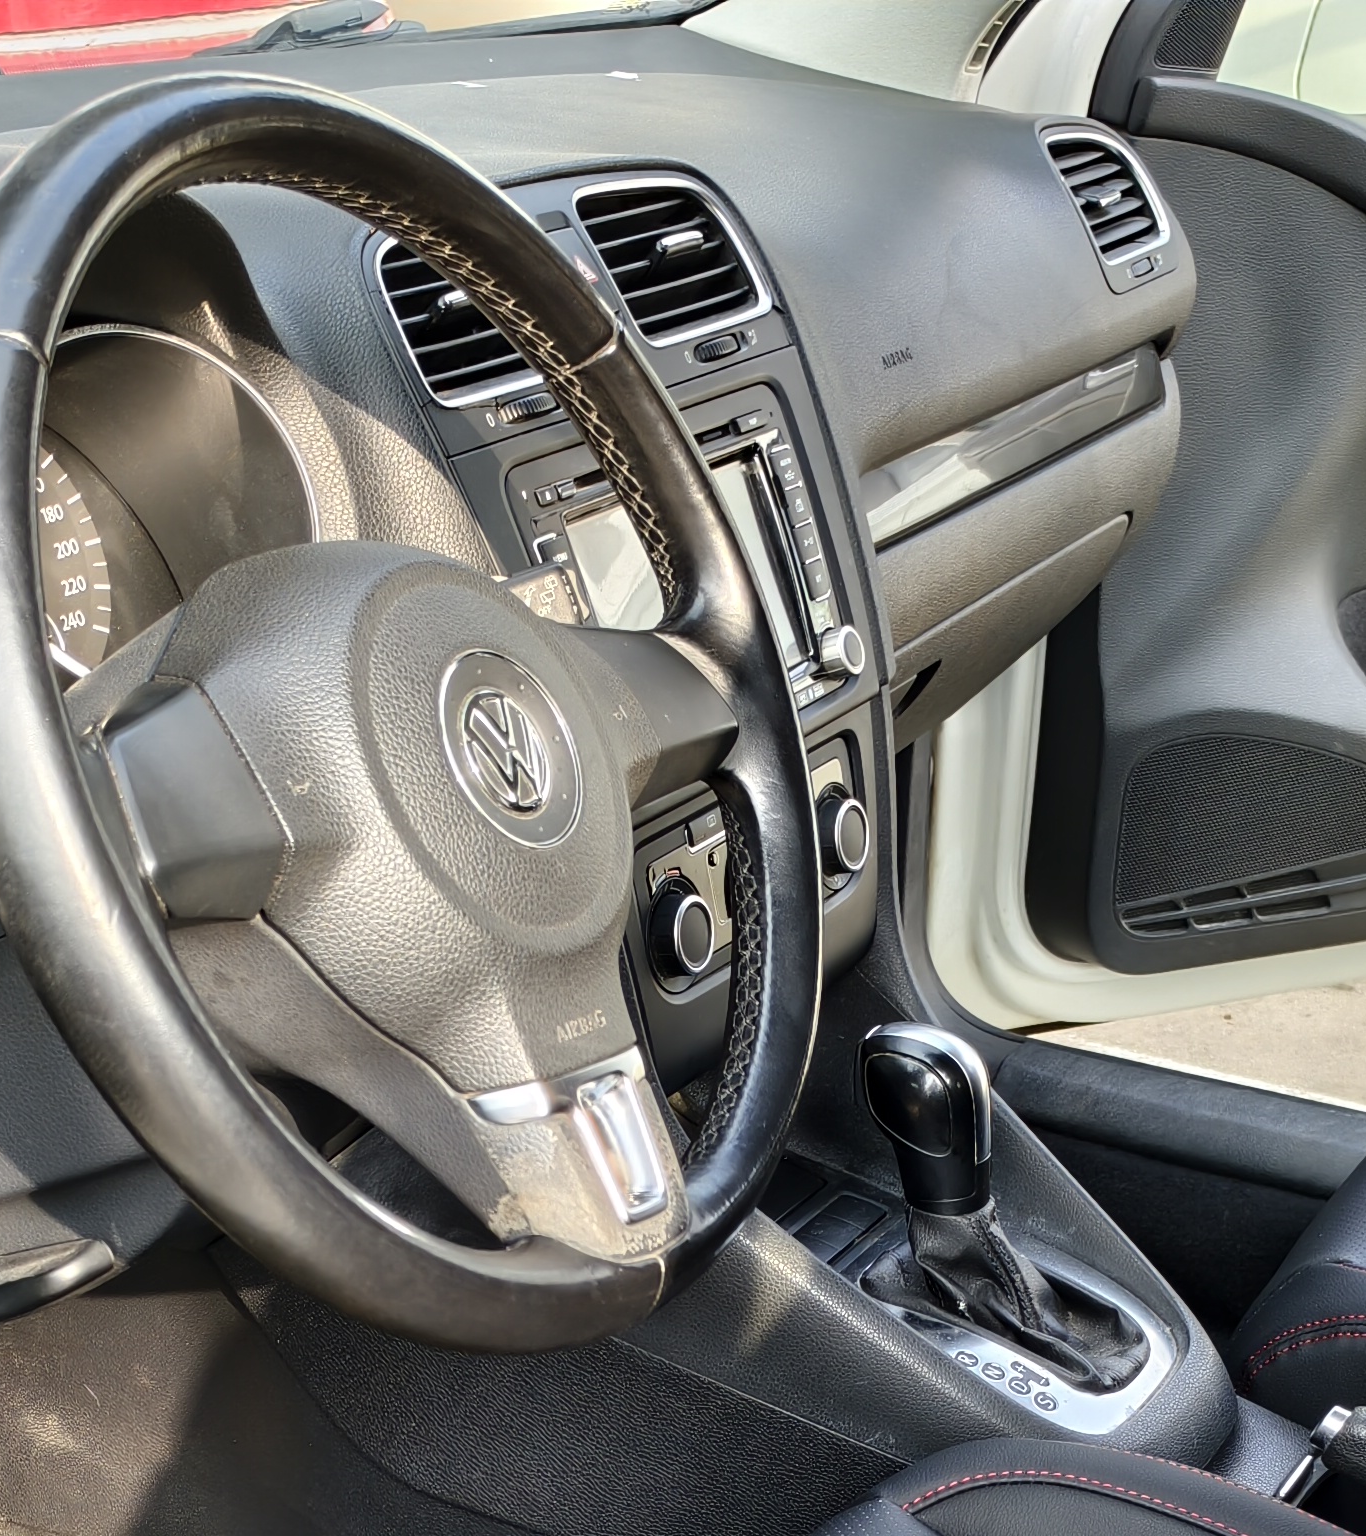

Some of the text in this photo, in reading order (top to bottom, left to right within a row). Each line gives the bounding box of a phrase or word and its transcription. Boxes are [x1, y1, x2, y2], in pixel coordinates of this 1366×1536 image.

[486, 413, 495, 428] 0
[40, 503, 64, 524] 180
[53, 538, 80, 560] 200
[61, 575, 86, 597] 220
[538, 604, 551, 617] OFF
[59, 610, 86, 632] 240
[957, 1354, 976, 1366] R
[984, 1365, 1002, 1378] N
[1011, 1380, 1028, 1393] D
[1037, 1395, 1054, 1409] S
